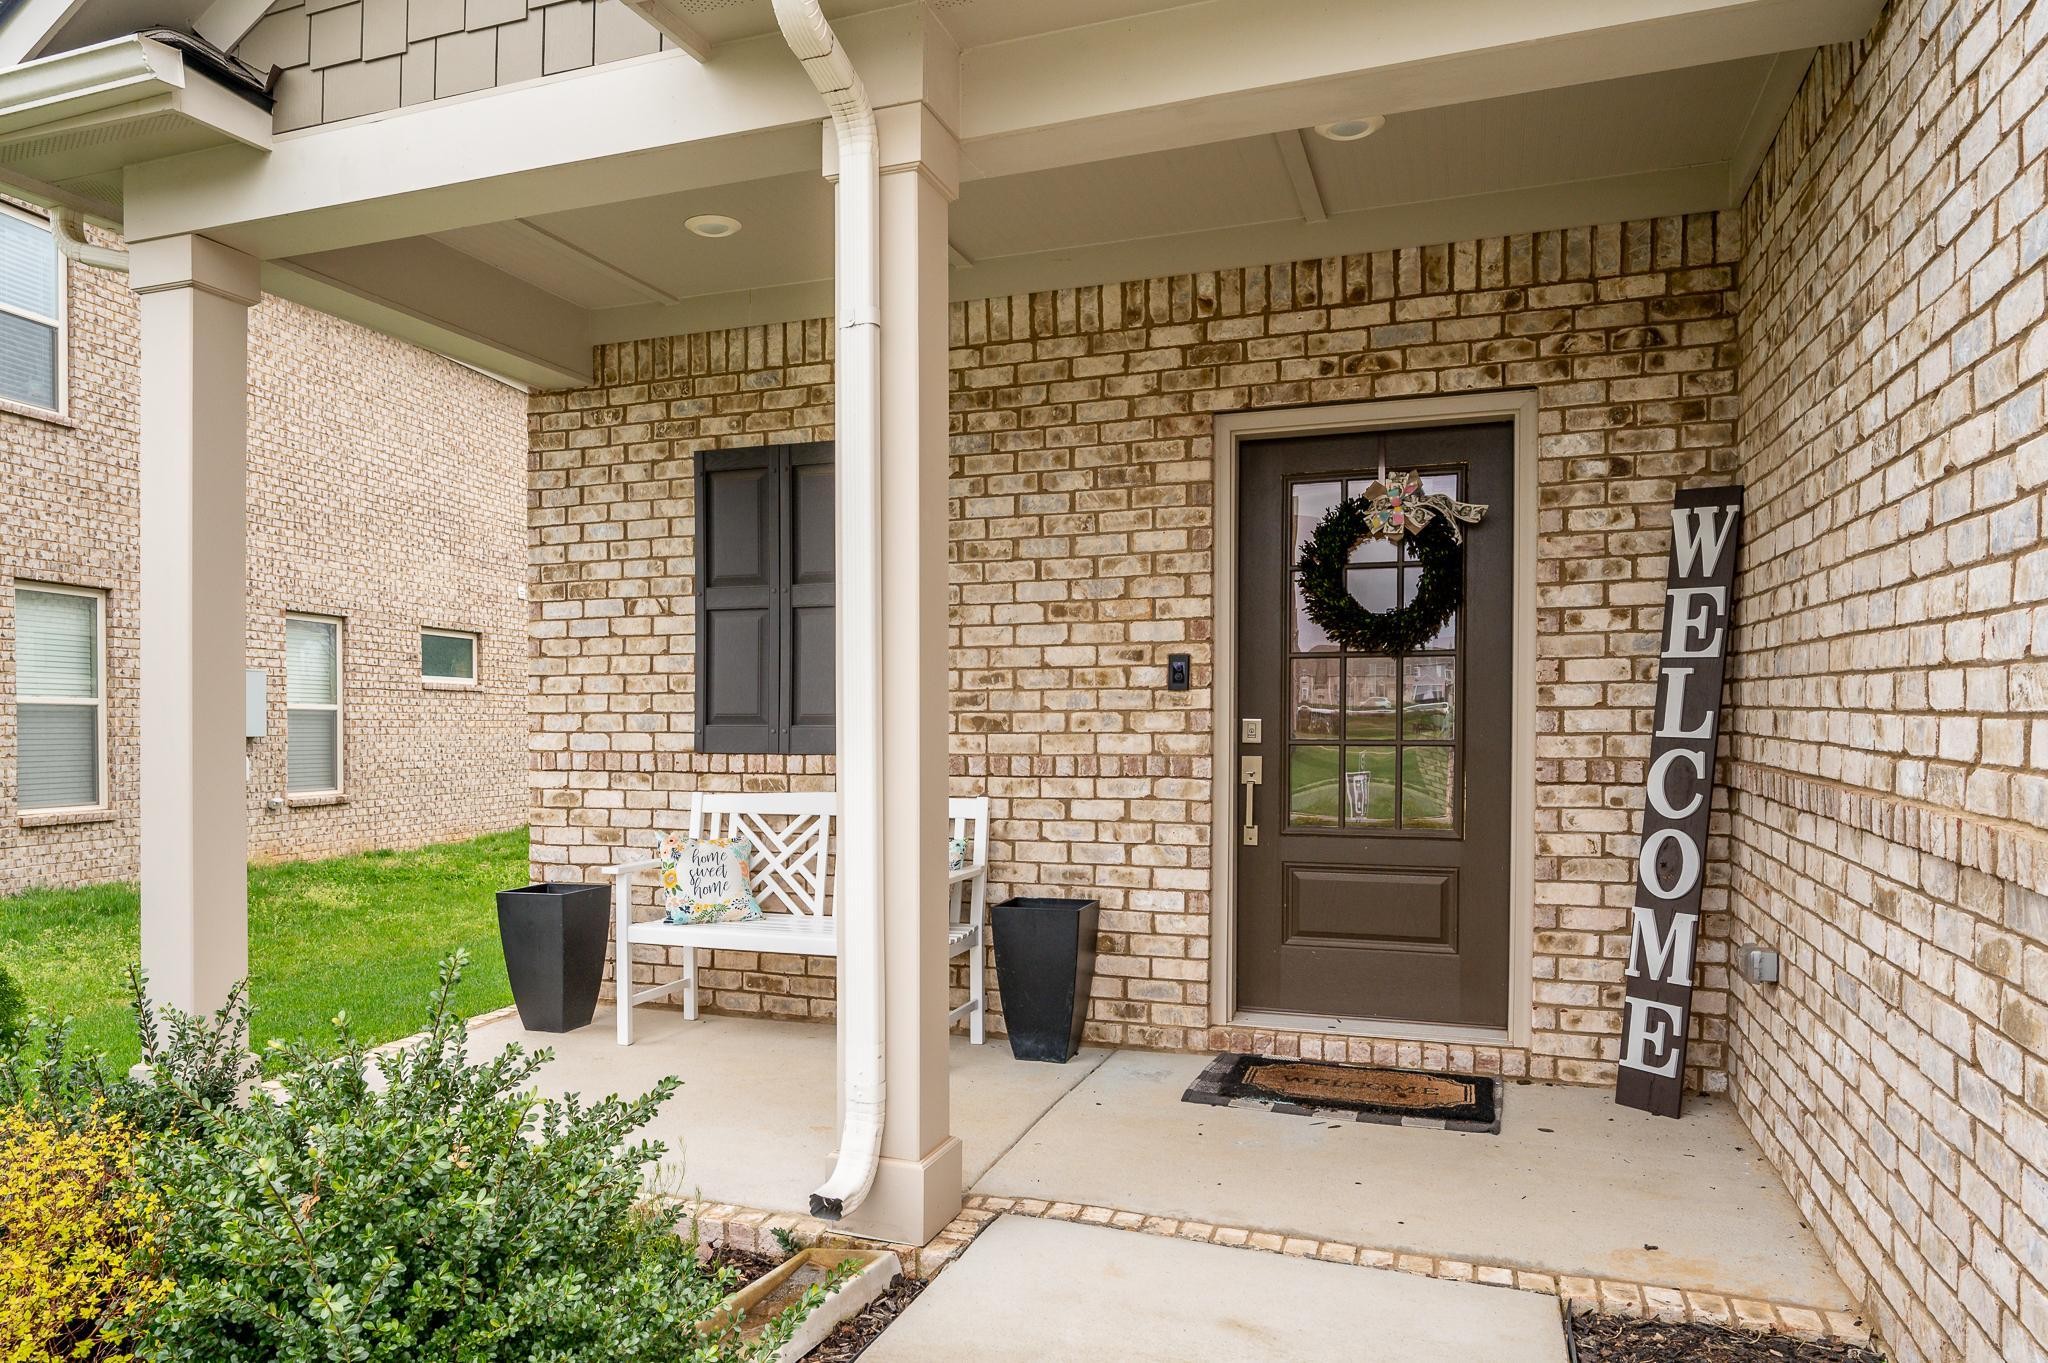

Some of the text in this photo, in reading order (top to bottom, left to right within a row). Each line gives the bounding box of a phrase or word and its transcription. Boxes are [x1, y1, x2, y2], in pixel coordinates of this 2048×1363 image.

[1619, 505, 1739, 1079] WELCOME
[692, 848, 728, 867] home
[689, 863, 728, 886] sweet
[693, 878, 730, 899] home
[1284, 1075, 1439, 1096] WELCOME
